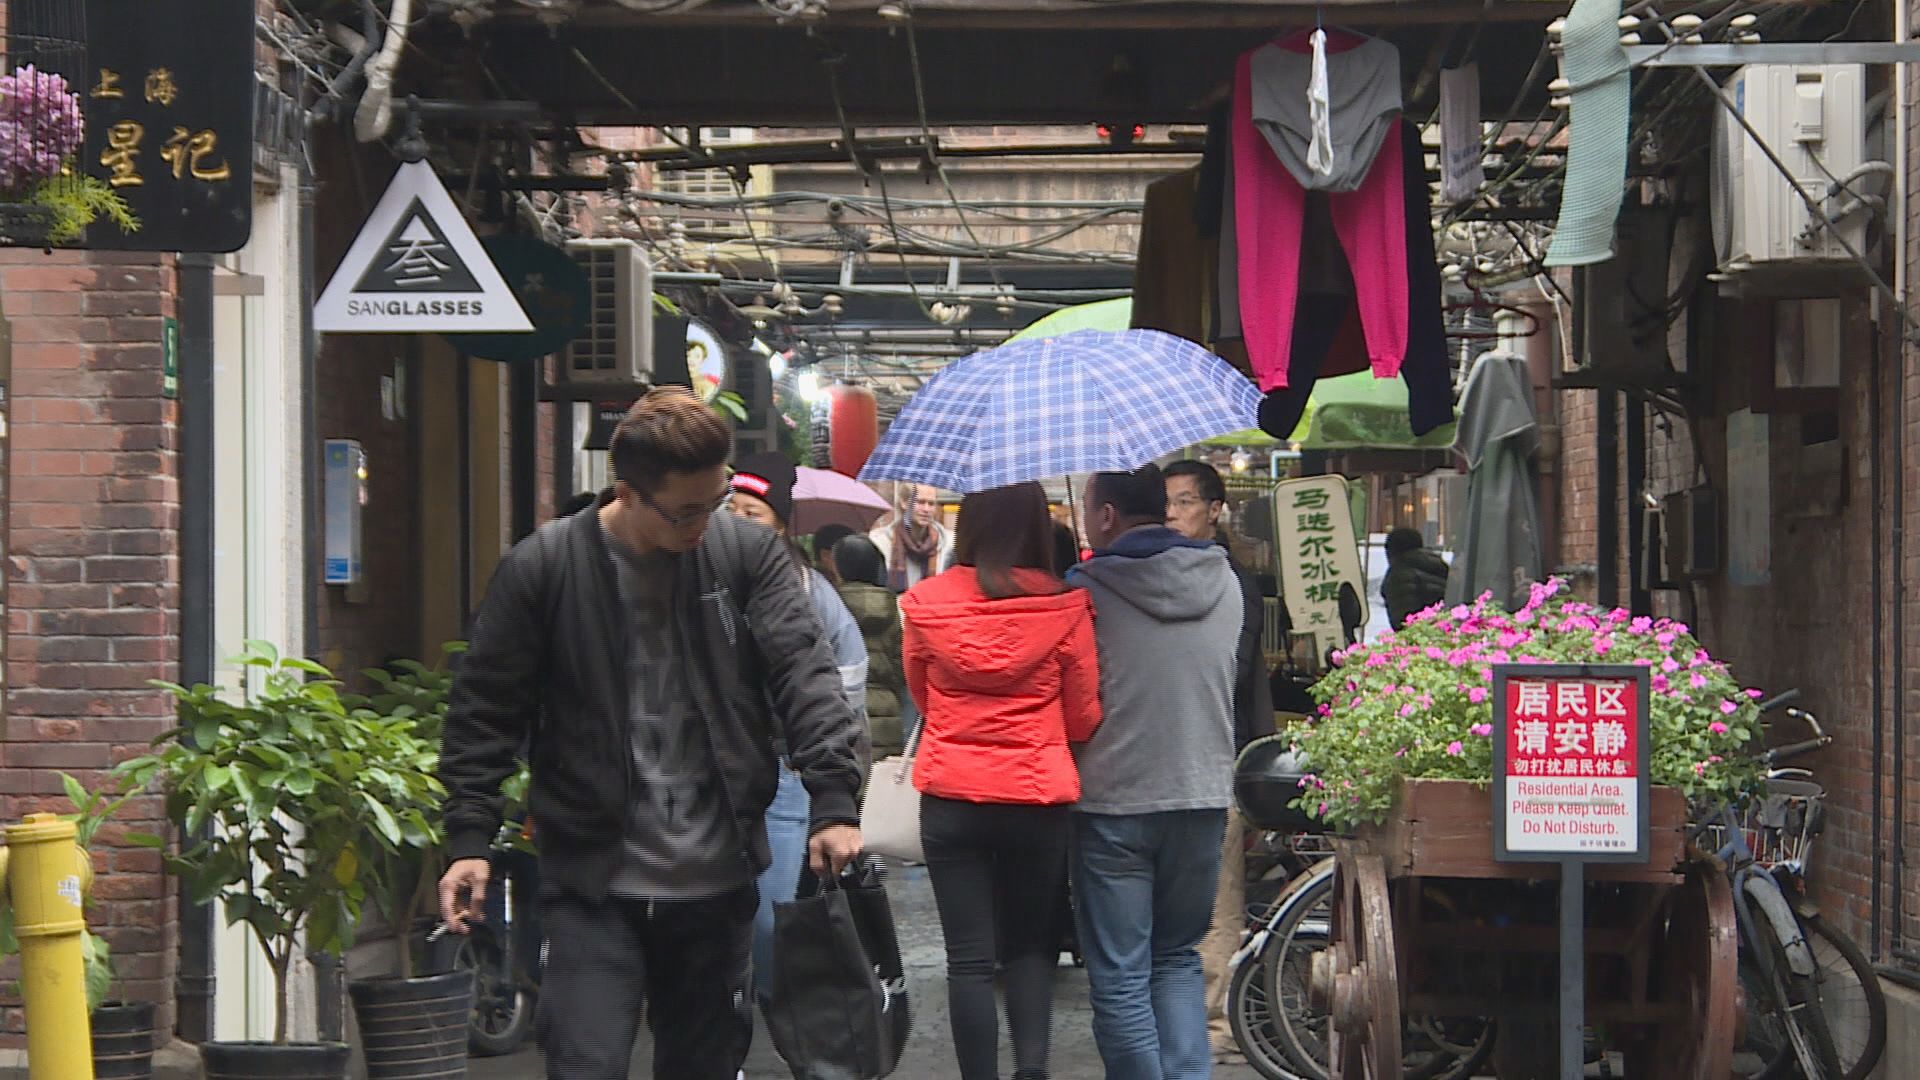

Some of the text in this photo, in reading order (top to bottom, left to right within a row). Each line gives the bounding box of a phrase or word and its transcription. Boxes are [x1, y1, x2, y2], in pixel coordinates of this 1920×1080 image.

[90, 67, 178, 106] 上海
[100, 119, 231, 187] 星记
[347, 300, 483, 316] SANGLASSES
[1515, 682, 1627, 717] 居民区
[1514, 718, 1627, 755] 请安静
[1514, 758, 1627, 775] 勿打扰居民休息
[1518, 781, 1624, 796] Residential Area.
[1512, 800, 1629, 817] Please Keep Quiet.
[1522, 820, 1620, 834] Do Not Disturb.
